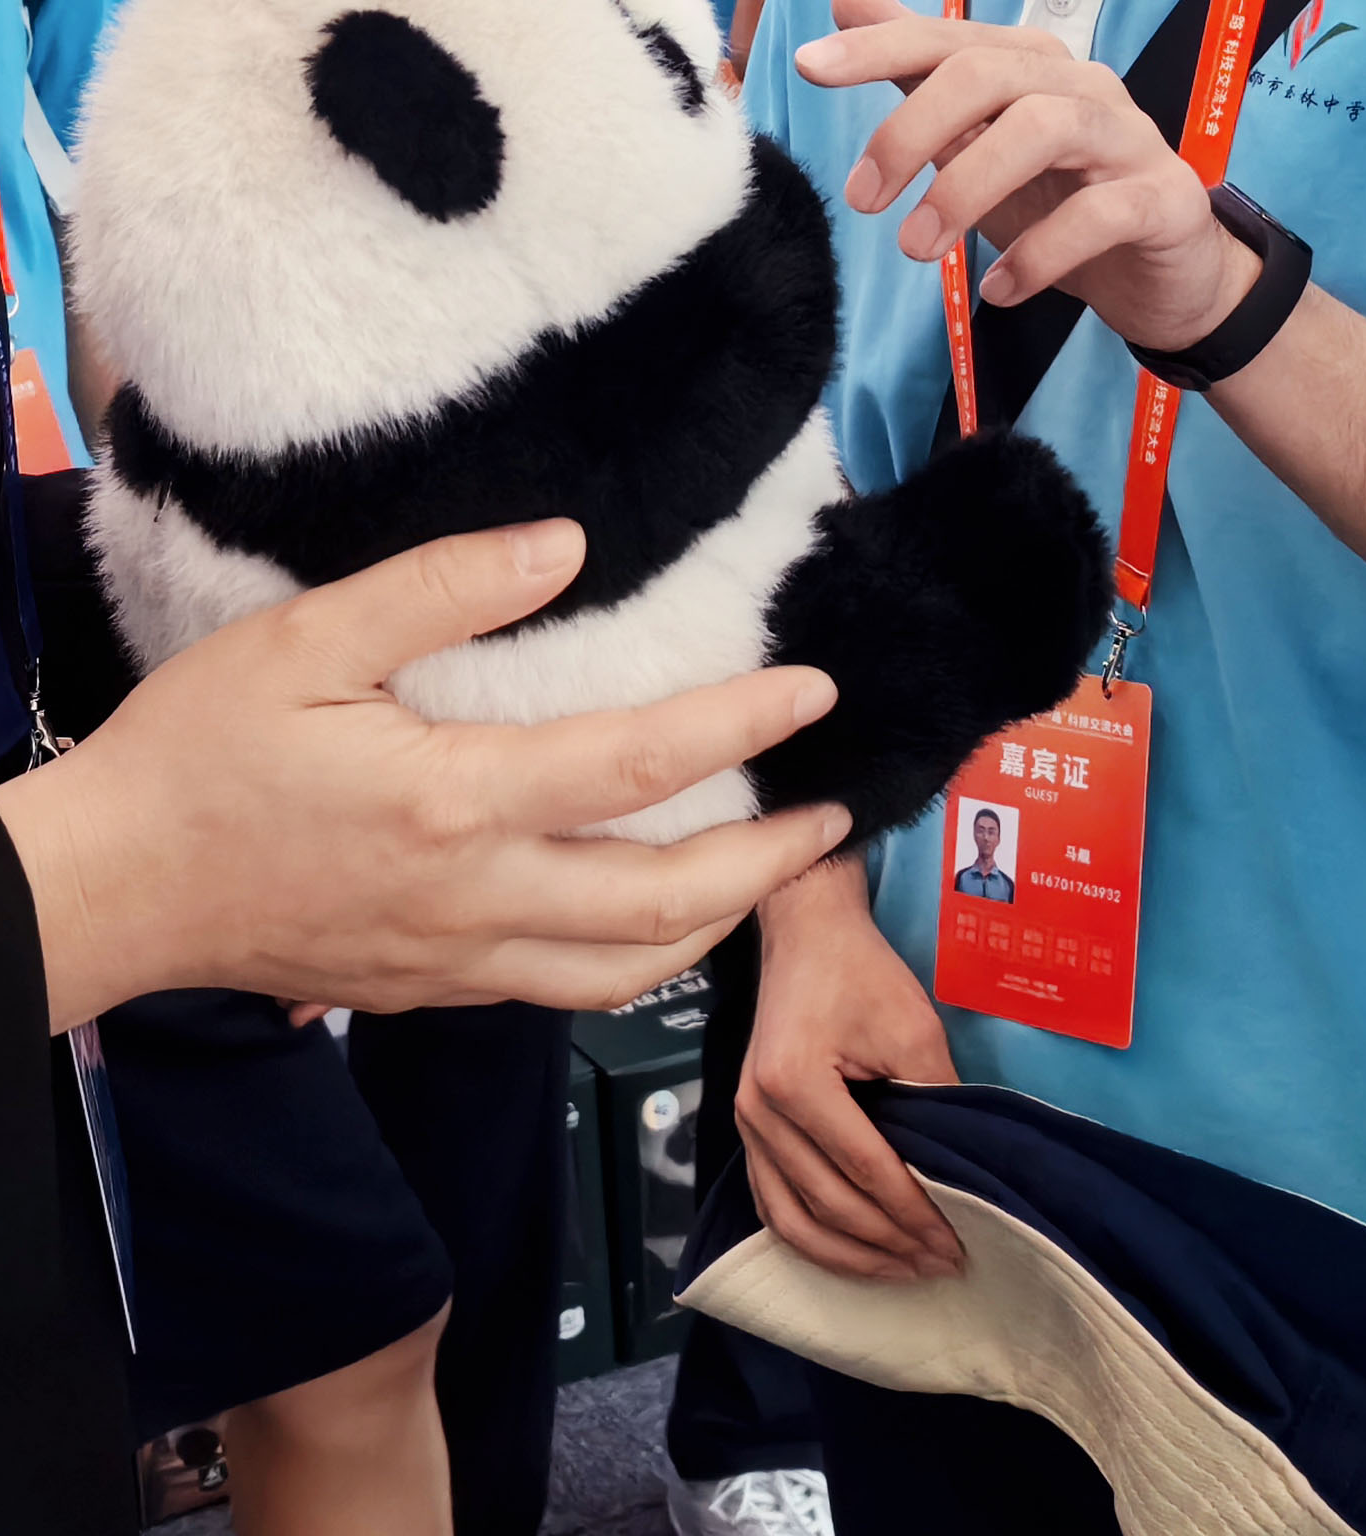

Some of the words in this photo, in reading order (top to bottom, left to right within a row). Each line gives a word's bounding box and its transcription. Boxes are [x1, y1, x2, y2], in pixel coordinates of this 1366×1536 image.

[999, 741, 1091, 790] 嘉宾证
[1024, 786, 1060, 804] GUEST
